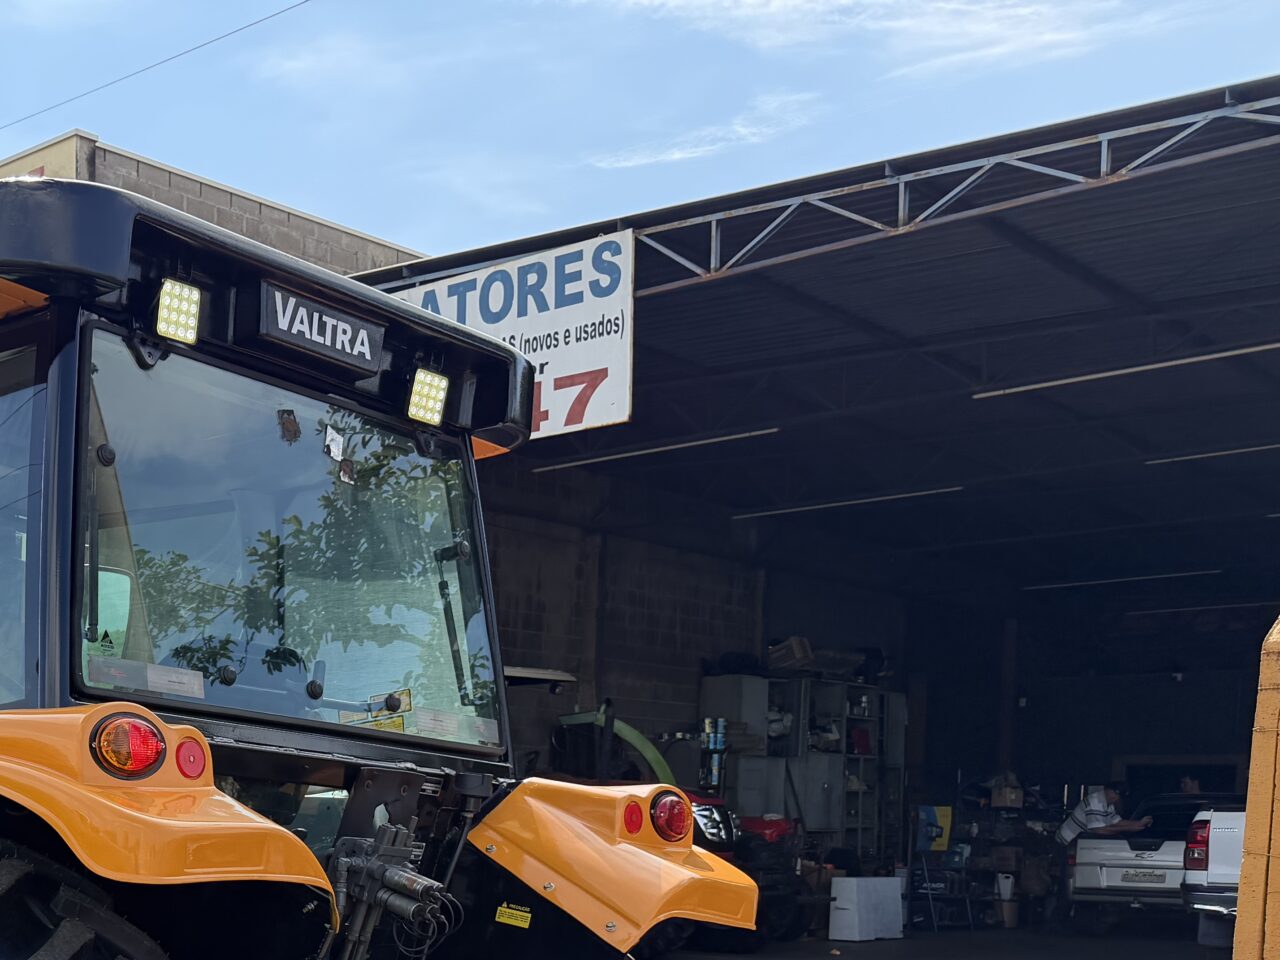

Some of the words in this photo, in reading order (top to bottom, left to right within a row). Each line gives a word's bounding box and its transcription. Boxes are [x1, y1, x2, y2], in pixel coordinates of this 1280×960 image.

[410, 240, 623, 325] ATORES
[274, 290, 372, 361] VALTRA
[520, 332, 559, 355] (novos
[563, 327, 571, 345] e
[575, 308, 625, 344] usados)
